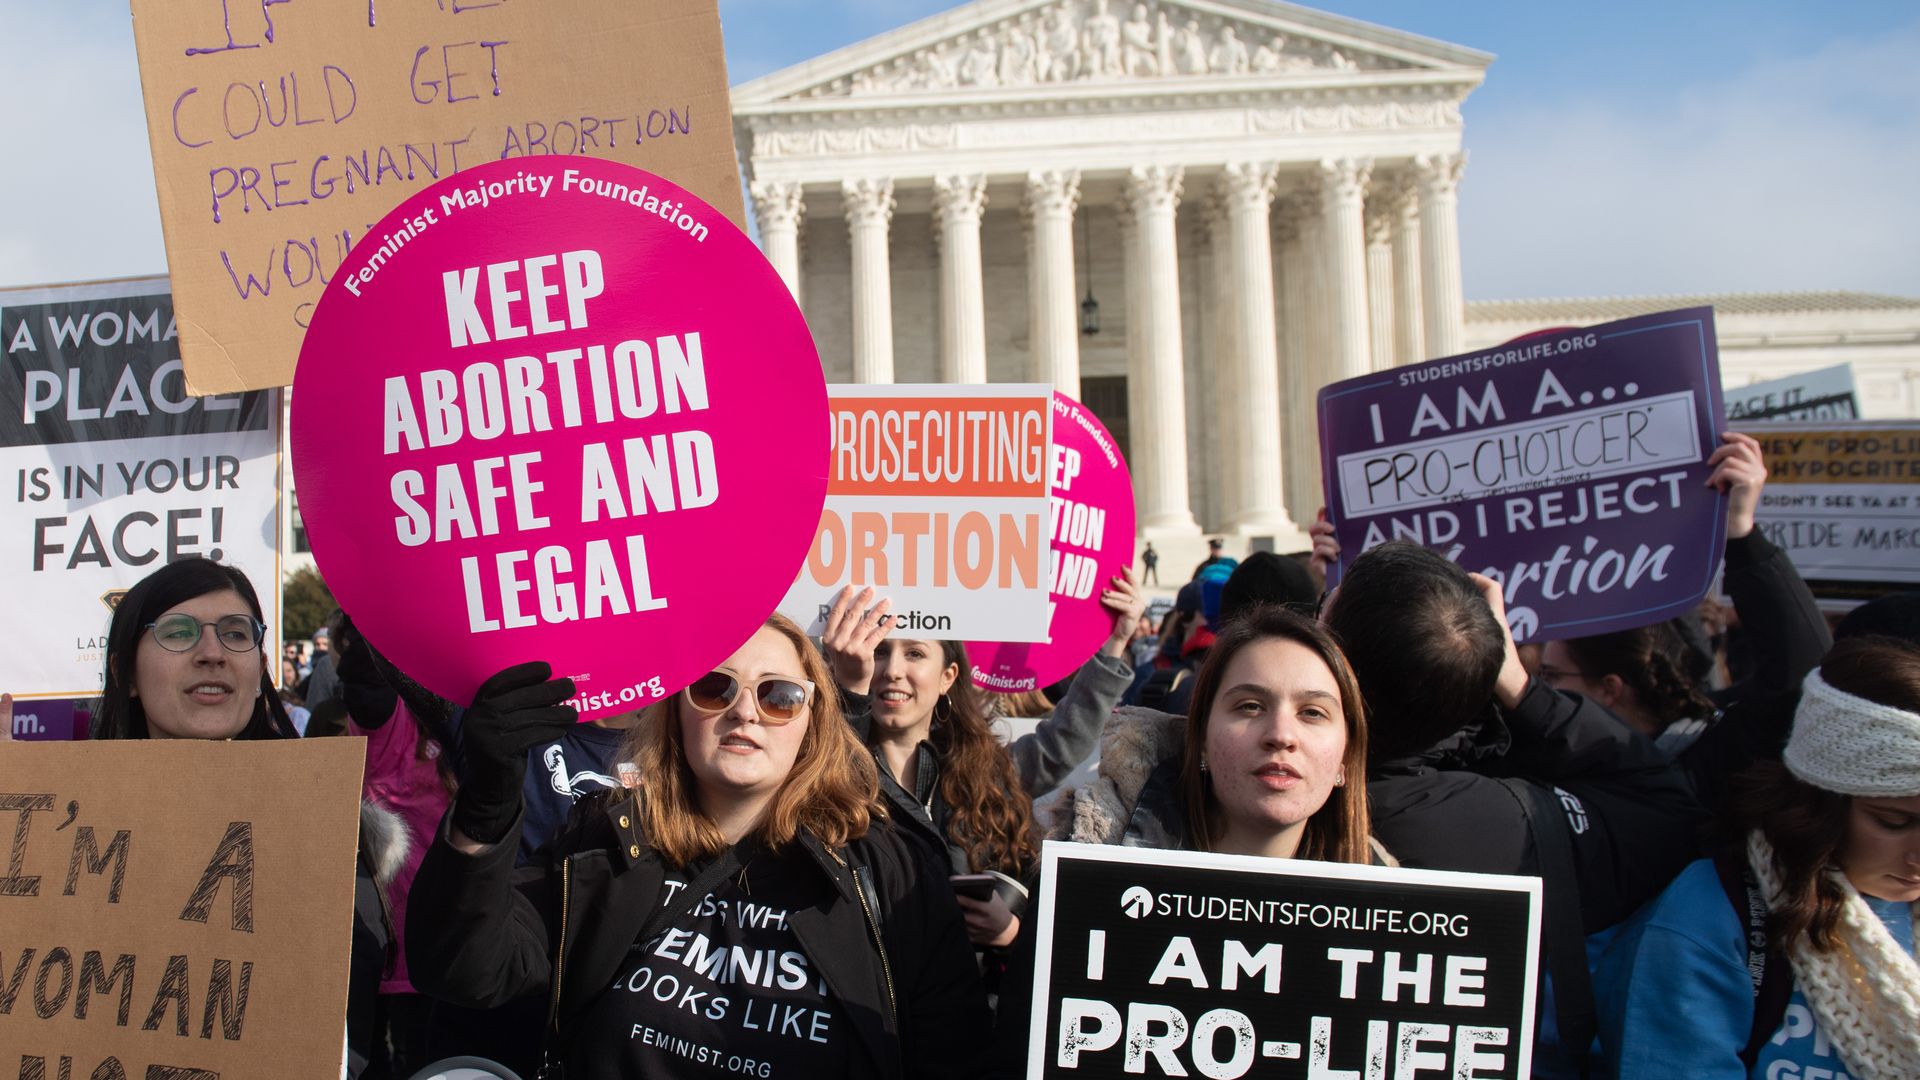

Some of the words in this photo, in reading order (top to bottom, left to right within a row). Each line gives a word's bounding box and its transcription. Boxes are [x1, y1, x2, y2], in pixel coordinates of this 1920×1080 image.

[172, 65, 357, 148] COULD
[410, 40, 511, 104] GET
[210, 133, 470, 224] PREGNANT
[500, 105, 690, 159] ABORTION
[220, 228, 376, 300] WOU
[343, 207, 439, 298] Feminist
[439, 171, 553, 217] Majority
[562, 169, 709, 243] Foundation
[8, 318, 37, 353] A
[48, 307, 178, 349] WOMA
[442, 249, 605, 348] KEEP
[384, 331, 710, 455] ABORTION
[1398, 333, 1598, 387] STUDENTSFORLIFE.ORG
[1071, 406, 1119, 469] Foundation
[1369, 403, 1385, 444] I
[1409, 380, 1507, 437] AM
[17, 467, 50, 503] IS
[63, 463, 104, 500] IN
[116, 455, 241, 495] YOUR
[390, 450, 551, 547] SAFE
[581, 429, 719, 523] AND
[1051, 443, 1081, 492] EP
[1050, 496, 1106, 552] TION
[1361, 510, 1460, 553] AND
[1475, 503, 1489, 538] I
[1504, 470, 1689, 534] REJECT
[1761, 495, 1818, 507] DIDN'T
[1824, 495, 1855, 507] SEE
[32, 506, 224, 572] FACE!
[797, 509, 1040, 590] ORTION
[460, 534, 668, 634] LEGAL
[559, 675, 666, 713] nist.org
[970, 665, 1036, 690] feminist.org
[0, 793, 132, 904] I'M
[178, 821, 254, 933] A
[1156, 893, 1470, 938] STUDENTSFORLIFE.ORG
[1087, 929, 1106, 981] I
[1148, 935, 1284, 994] AM
[1327, 947, 1488, 1008] THE
[630, 1023, 772, 1078] FEMINIST.ORG
[743, 999, 832, 1044] LIKE
[1057, 997, 1510, 1080] PRO-LIFE
